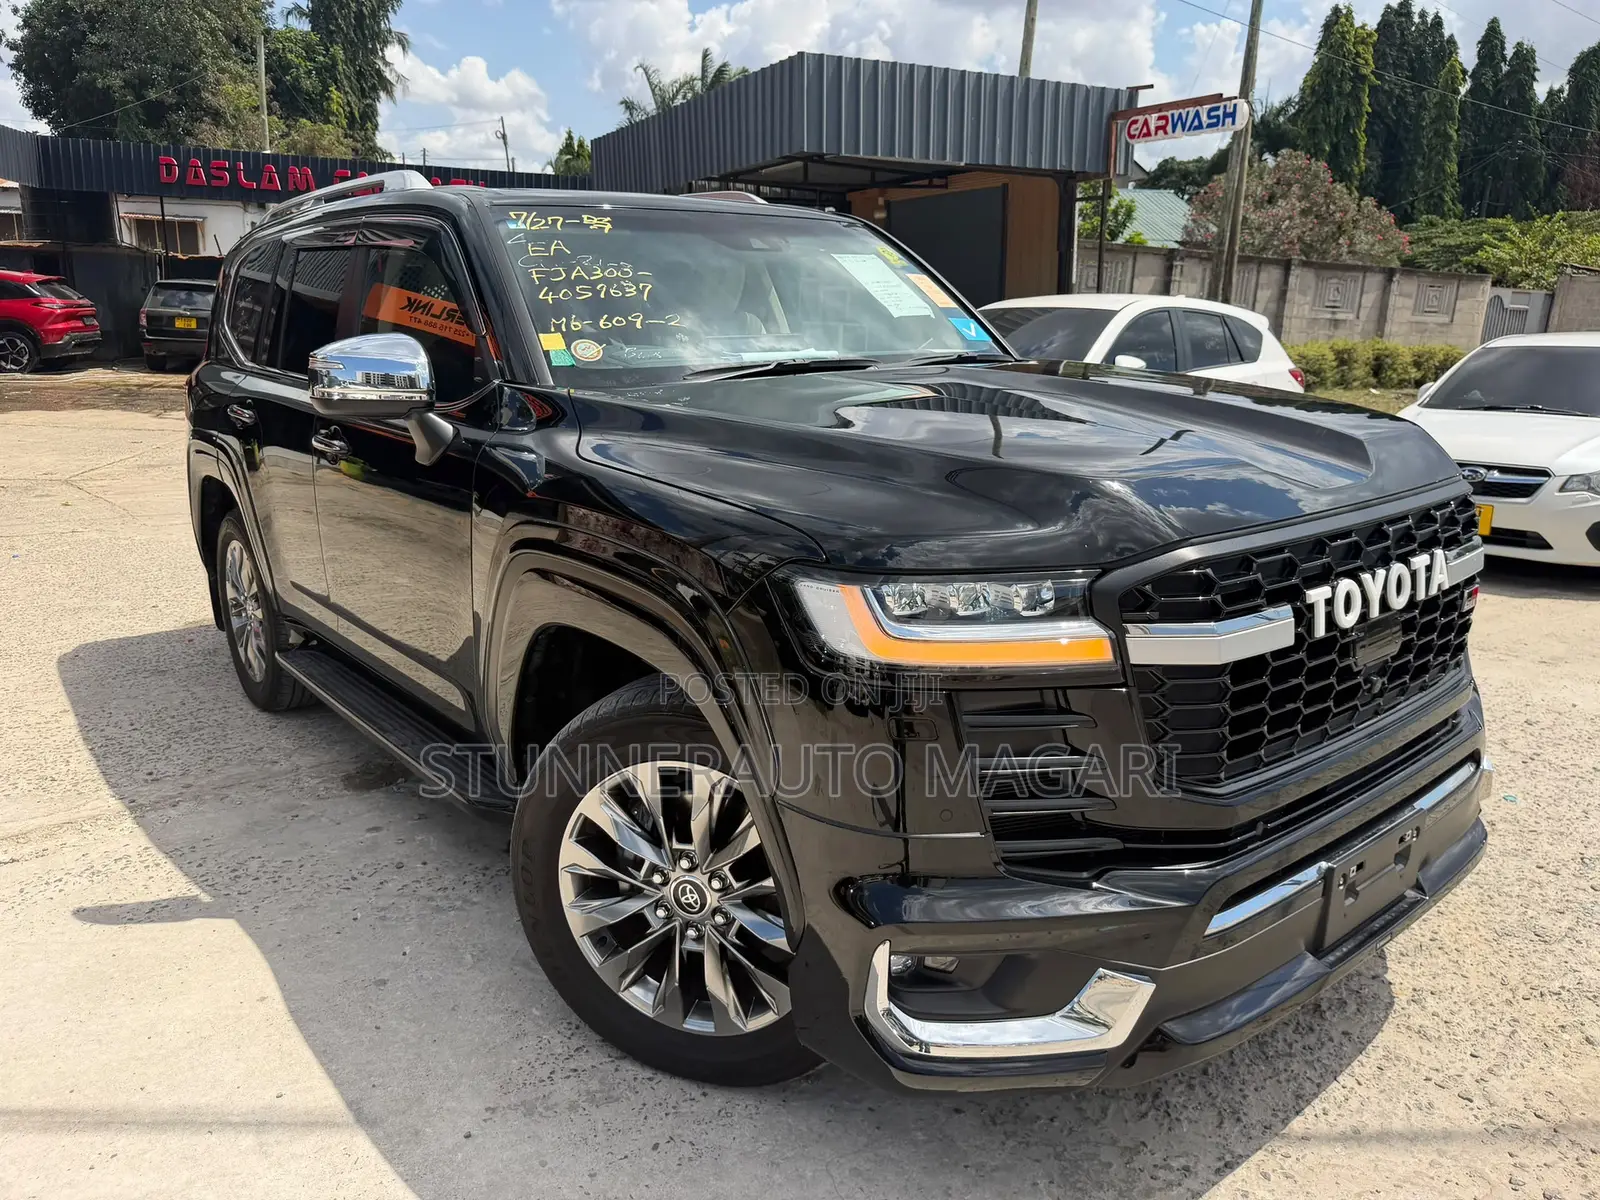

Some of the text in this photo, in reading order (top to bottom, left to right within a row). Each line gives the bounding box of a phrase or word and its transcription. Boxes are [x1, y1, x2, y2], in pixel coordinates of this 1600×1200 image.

[1127, 103, 1237, 139] CARWASH
[159, 156, 315, 191] DASLAM
[1306, 549, 1449, 638] TOYOTA
